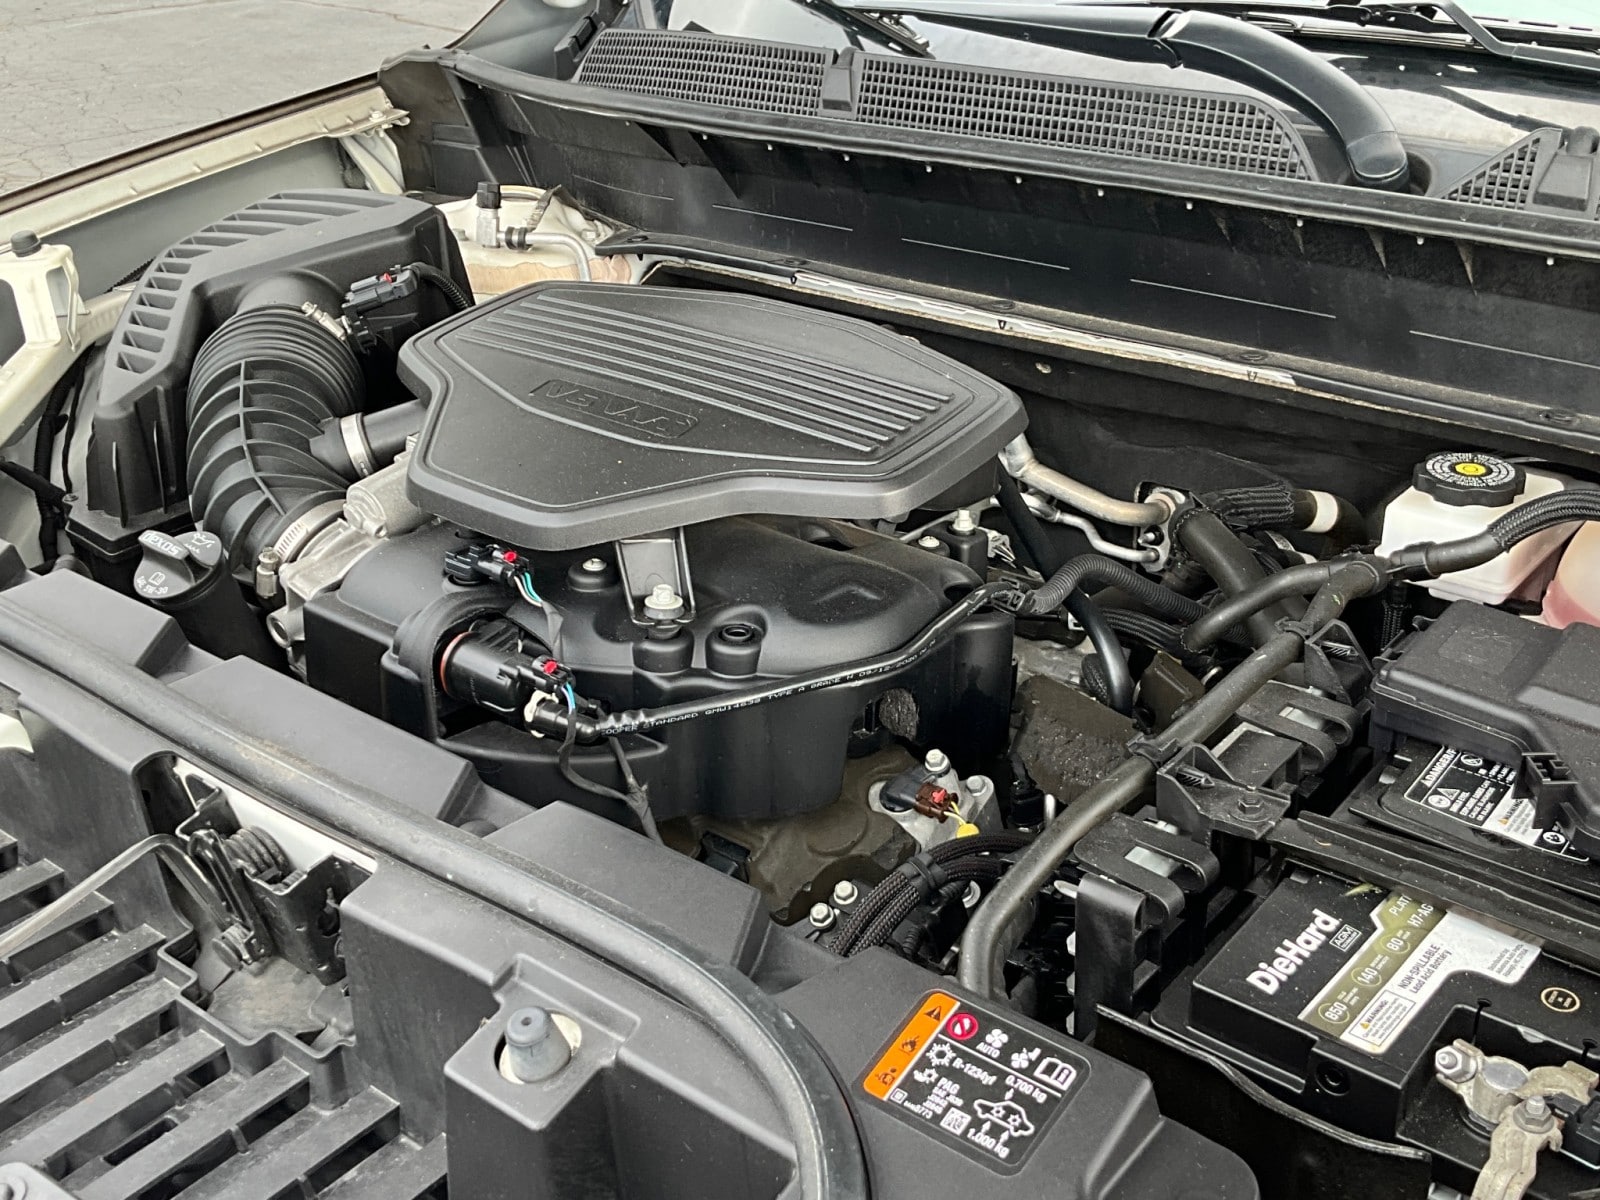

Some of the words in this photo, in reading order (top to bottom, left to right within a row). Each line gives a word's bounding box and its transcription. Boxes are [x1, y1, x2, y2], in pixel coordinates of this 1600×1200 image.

[143, 531, 184, 556] dexos
[643, 711, 699, 729] STANDARD
[767, 689, 793, 700] TYPE
[798, 685, 806, 693] A
[1334, 926, 1354, 946] AGM
[1386, 937, 1405, 951] 80
[1245, 908, 1341, 995] DieHard
[1357, 967, 1378, 984] 140
[1397, 943, 1441, 990] NON-SPILLABLE
[1408, 978, 1426, 994] Lead
[1324, 1001, 1347, 1021] 850
[975, 1041, 1000, 1058] AUTO
[952, 1057, 998, 1085] R-1234yf
[937, 1077, 961, 1096] PAG
[1005, 1074, 1035, 1095] 0.700
[1031, 1087, 1048, 1104] kg
[966, 1127, 996, 1149] 1.000
[993, 1140, 1010, 1159] kg
